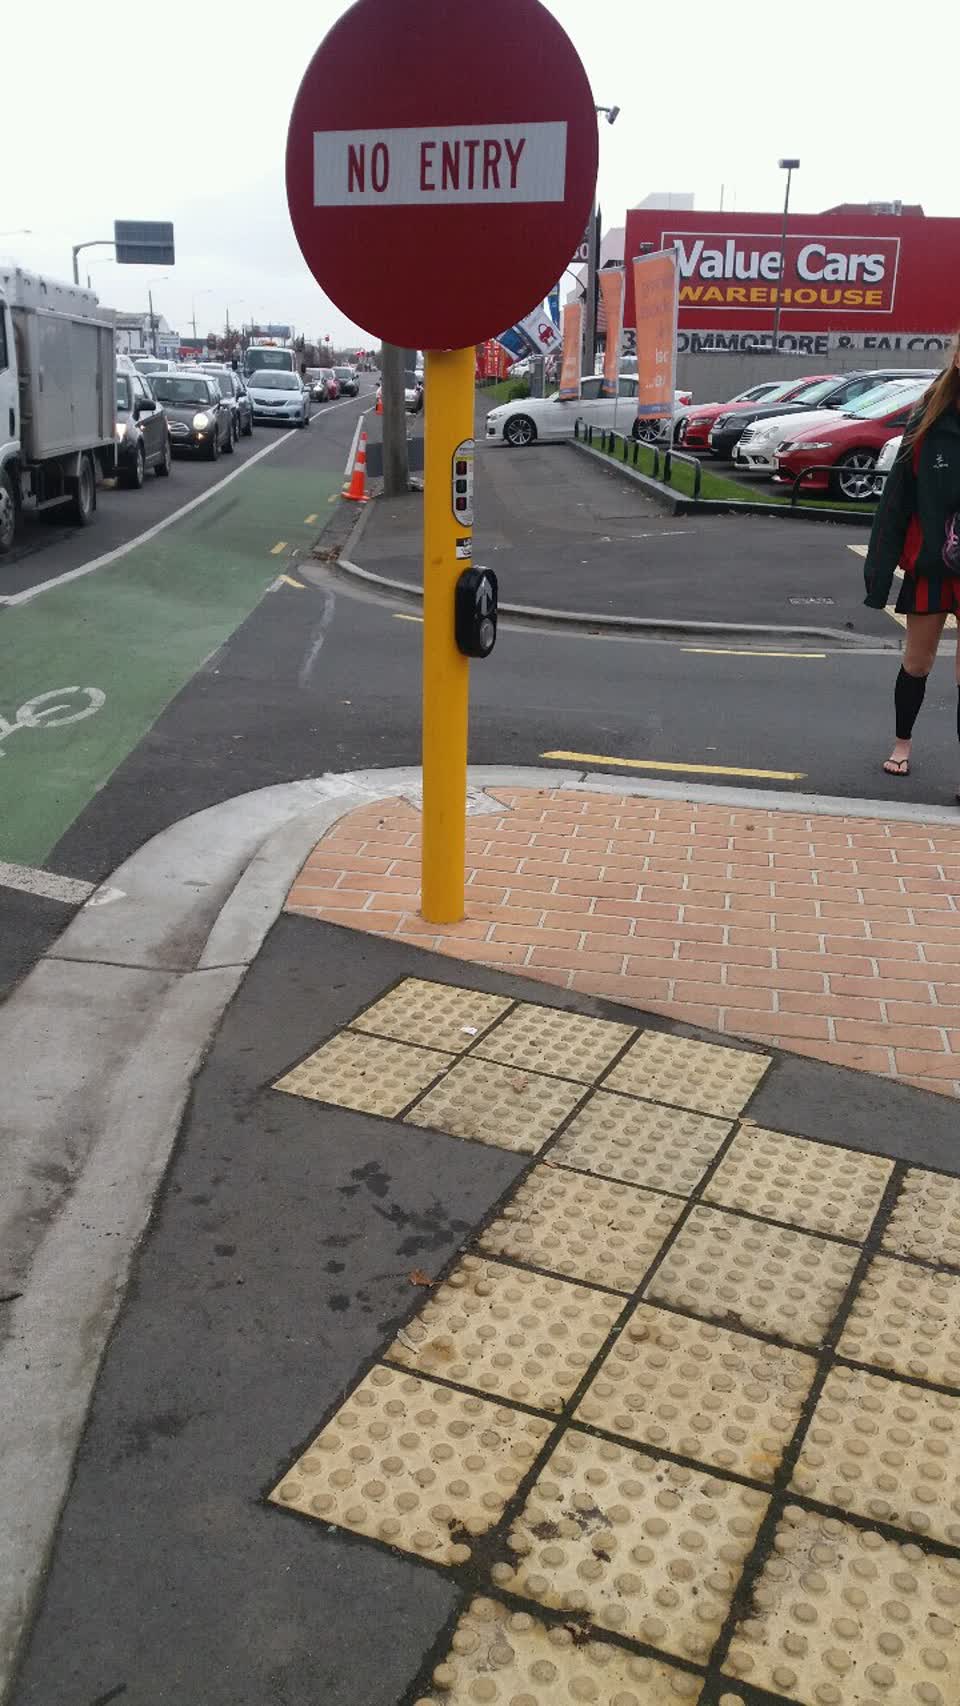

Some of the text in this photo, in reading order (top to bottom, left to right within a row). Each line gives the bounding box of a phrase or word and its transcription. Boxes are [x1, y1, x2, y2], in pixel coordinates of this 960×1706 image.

[347, 138, 526, 193] NO ENTRY
[673, 239, 885, 282] Value Cars
[679, 286, 883, 305] WAREHOUSE
[677, 332, 826, 354] OMMODORE
